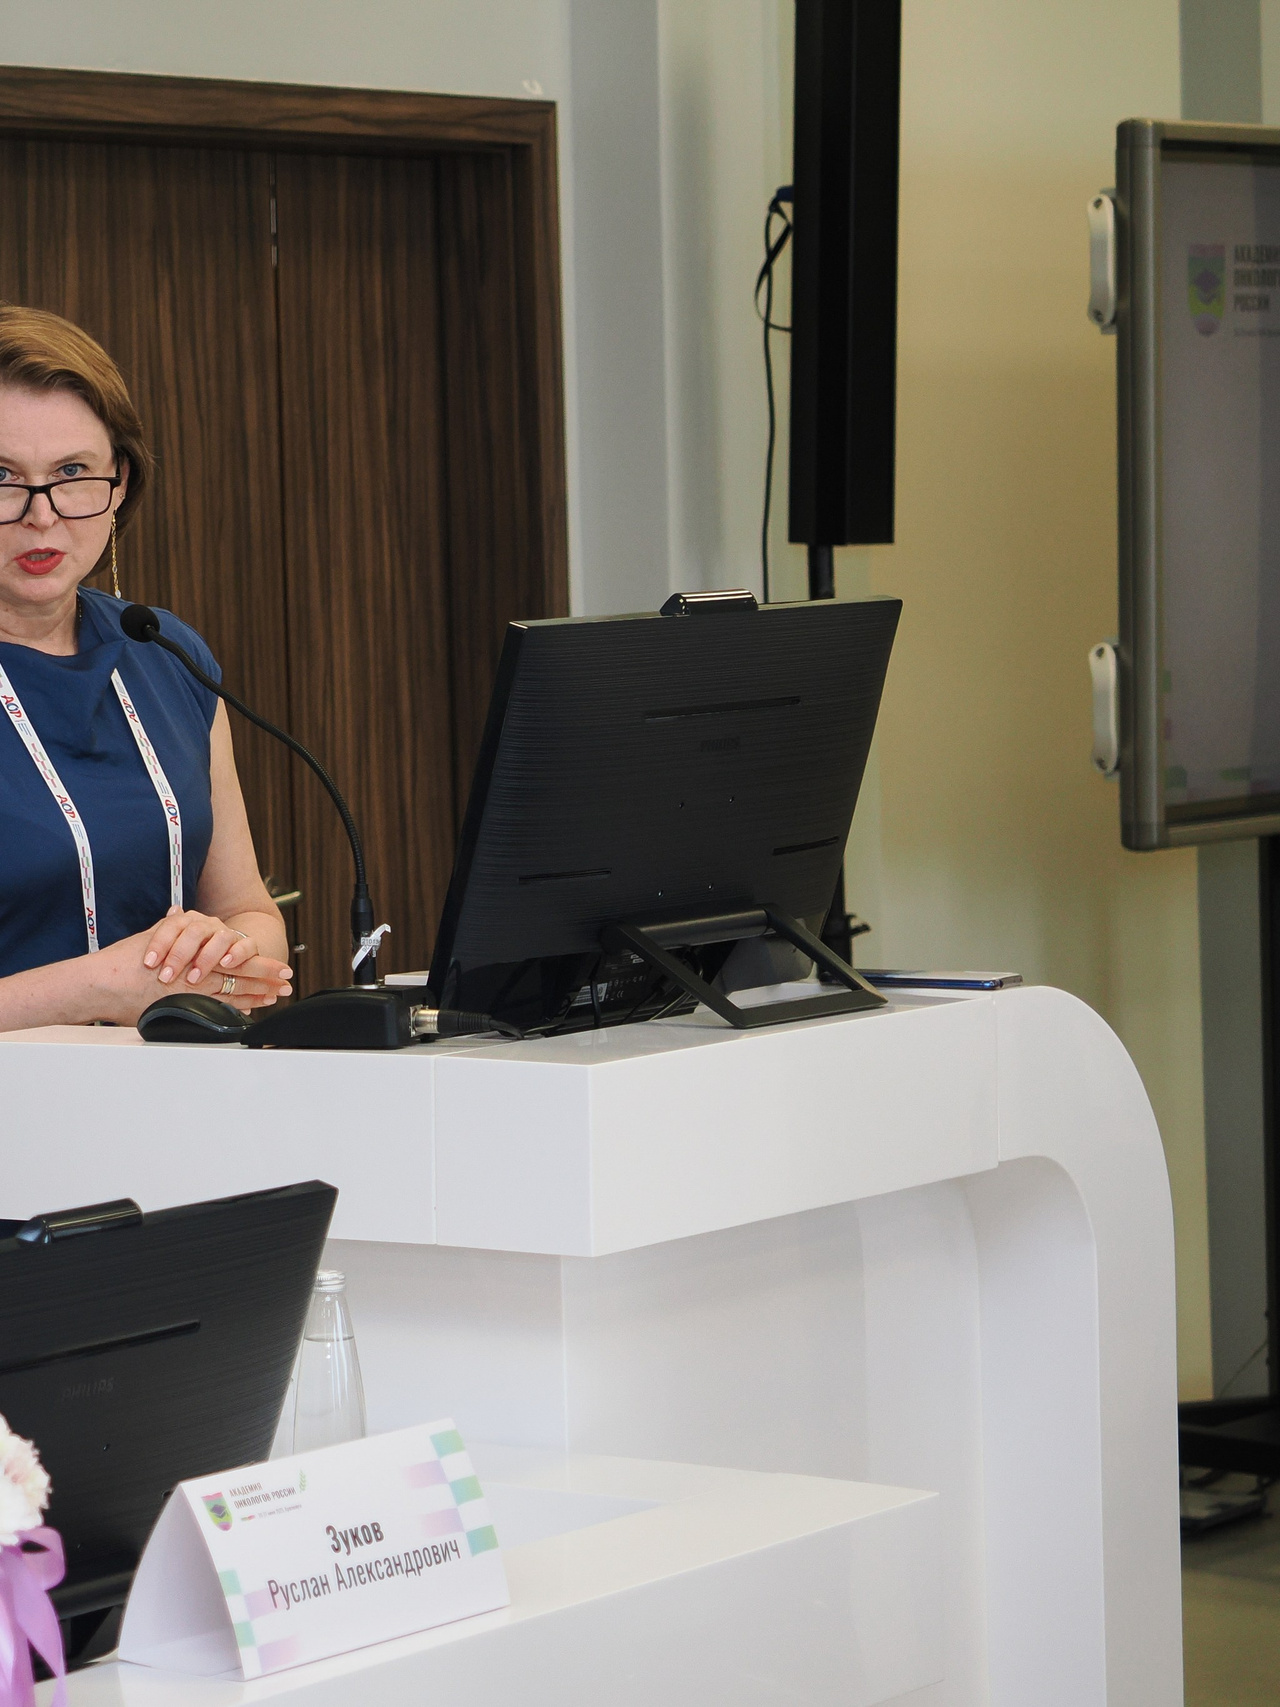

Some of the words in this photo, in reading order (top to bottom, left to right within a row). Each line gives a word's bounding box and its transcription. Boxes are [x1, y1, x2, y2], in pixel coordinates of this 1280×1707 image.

[229, 1482, 263, 1497] АКАДЕМИЯ
[233, 1493, 272, 1509] ОНКОЛОГОВ
[272, 1487, 296, 1501] РОССИИ
[325, 1520, 385, 1556] Зуков
[267, 1573, 331, 1611] Руслан
[334, 1539, 461, 1592] Александрович
